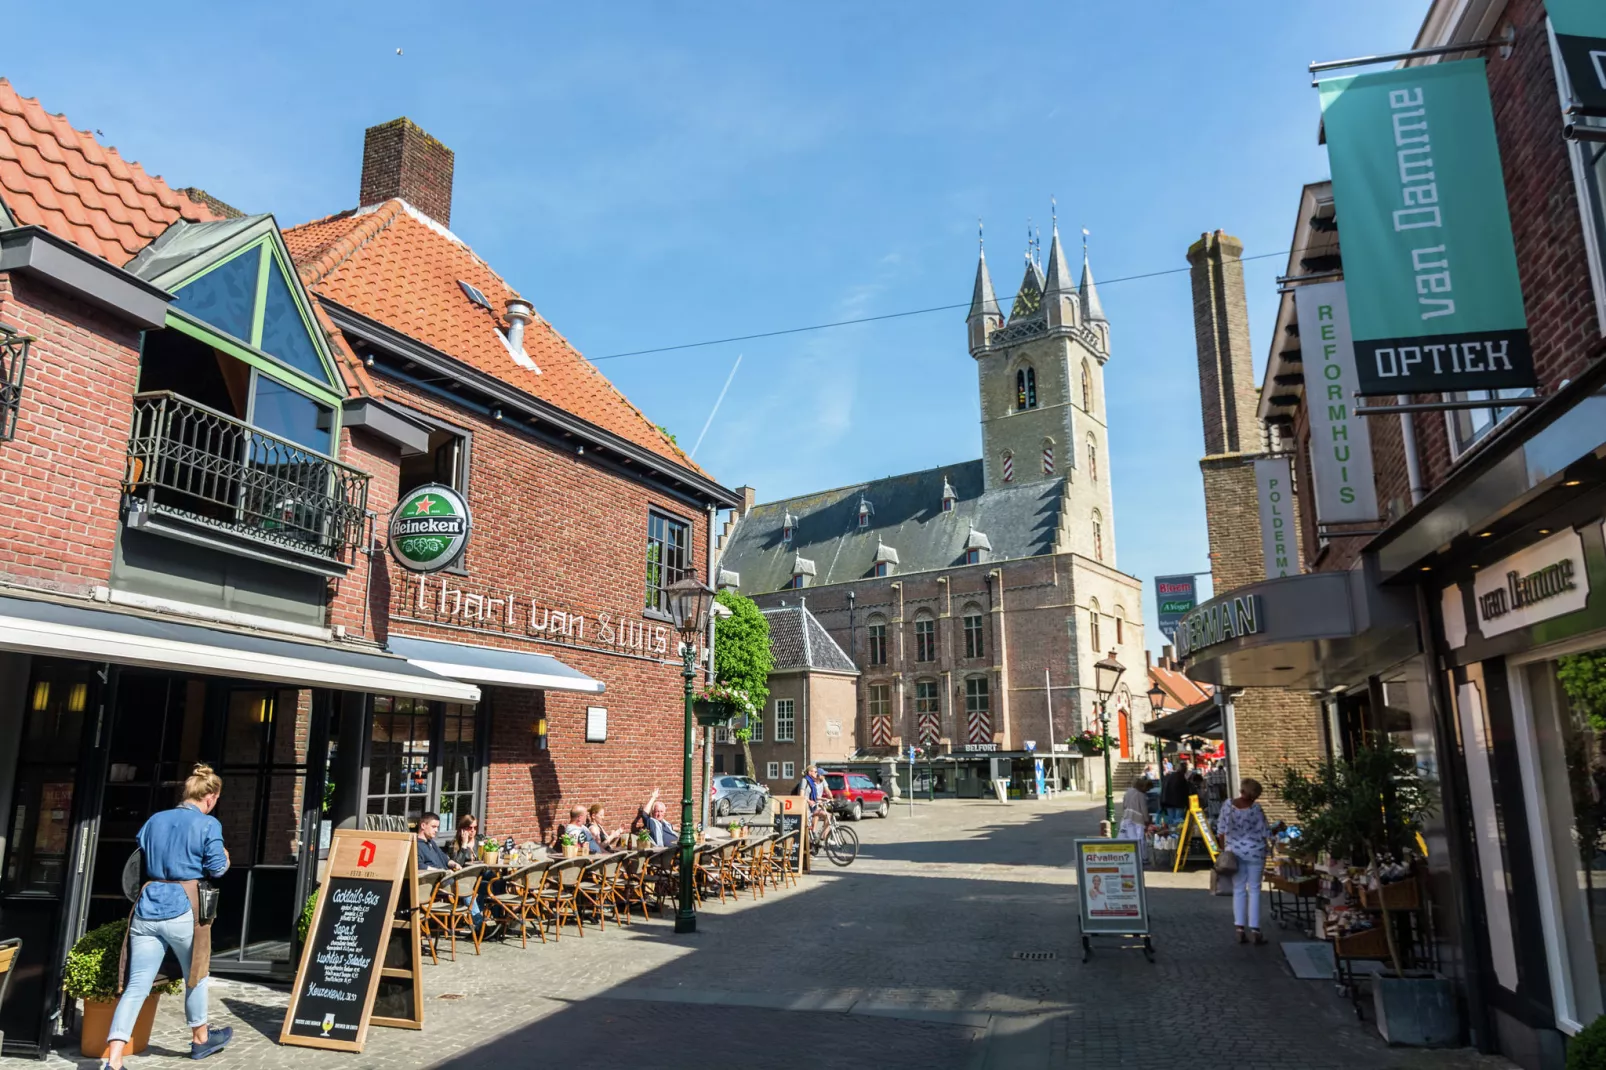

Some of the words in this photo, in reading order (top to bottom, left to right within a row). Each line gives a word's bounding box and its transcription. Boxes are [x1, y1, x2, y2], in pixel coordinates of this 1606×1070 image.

[1389, 87, 1443, 233] Damme
[1411, 244, 1456, 321] van
[1375, 339, 1513, 378] OPTIEK
[1317, 304, 1356, 505] REFORMHUIS
[393, 518, 460, 536] Heineken
[1478, 587, 1509, 621] van
[1506, 569, 1577, 611] Damme
[531, 598, 584, 639] van
[965, 743, 998, 752] BELFORT
